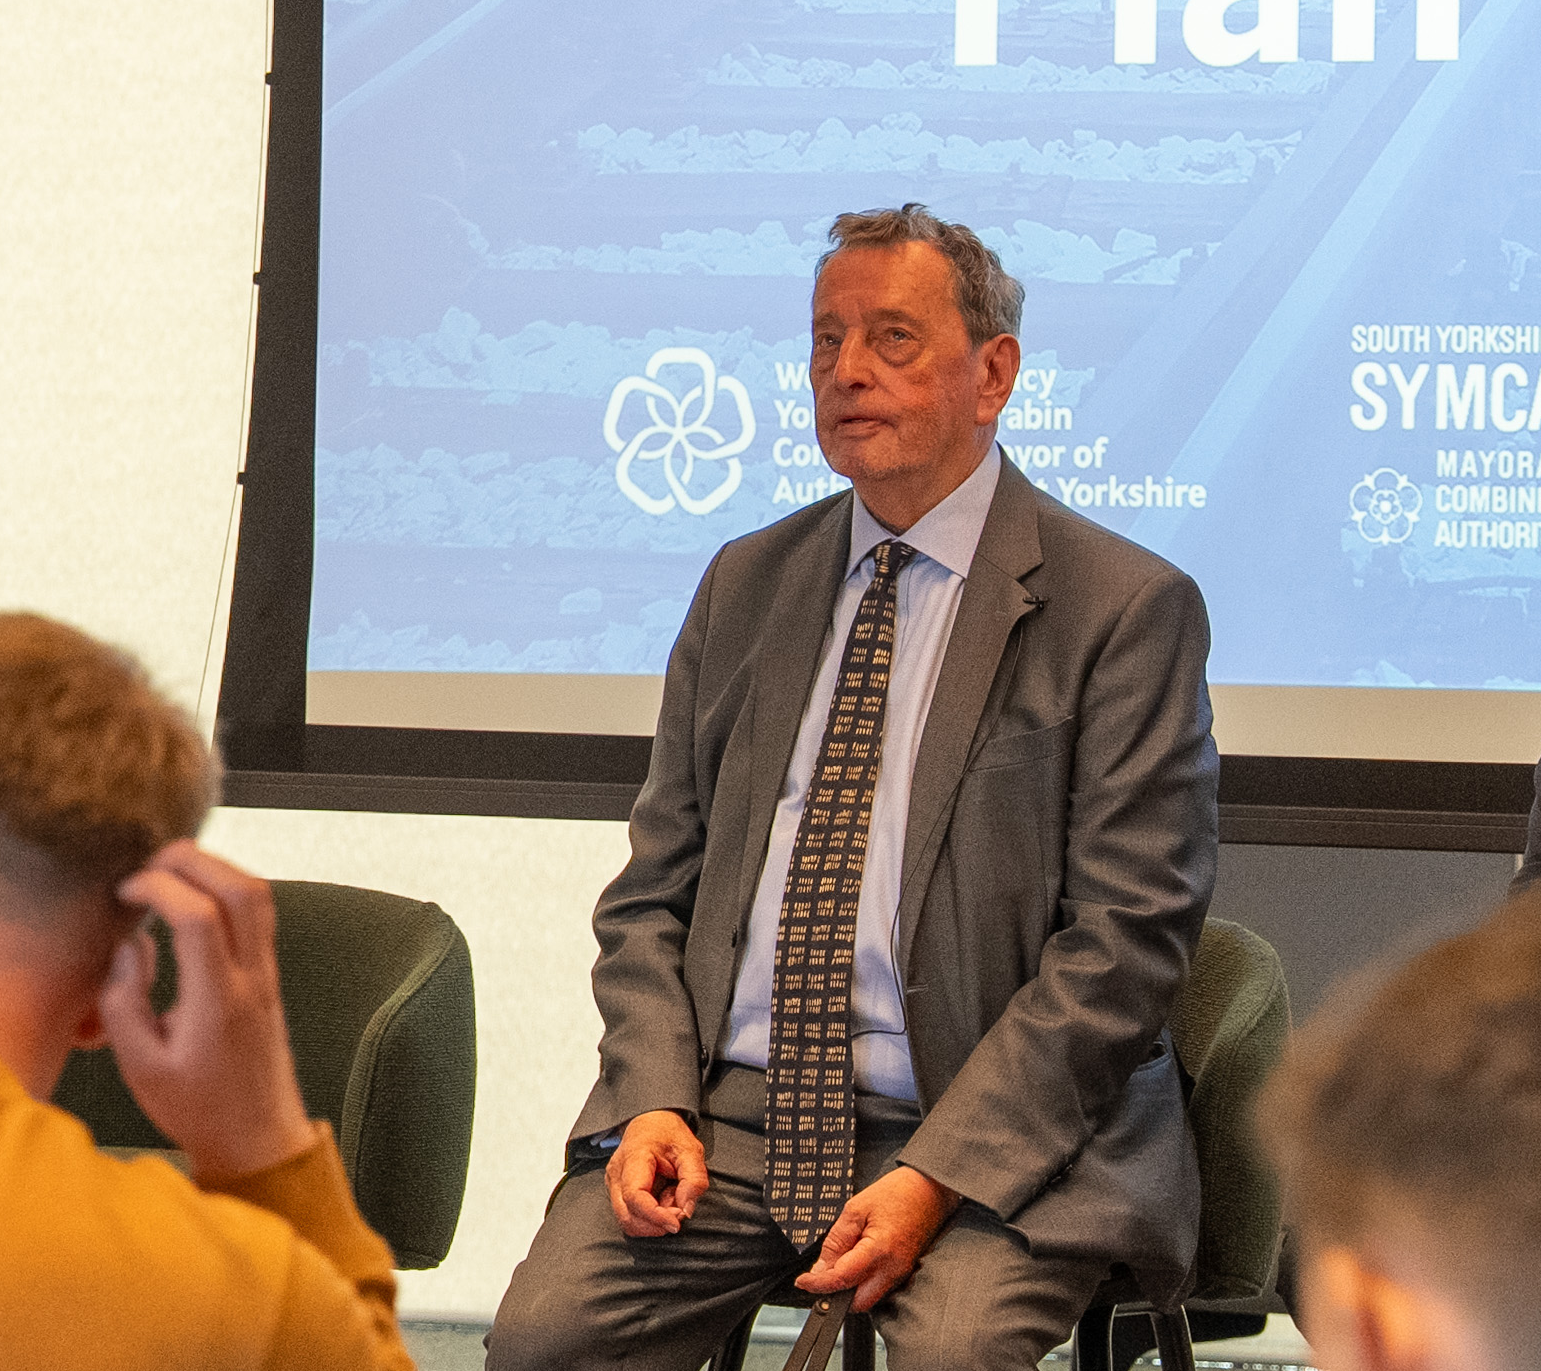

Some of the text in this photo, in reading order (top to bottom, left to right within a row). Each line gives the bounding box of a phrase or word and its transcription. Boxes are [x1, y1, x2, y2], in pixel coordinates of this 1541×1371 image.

[1351, 324, 1430, 353] SOUTH
[1073, 436, 1109, 469] of
[1056, 475, 1207, 508] Yorkshire
